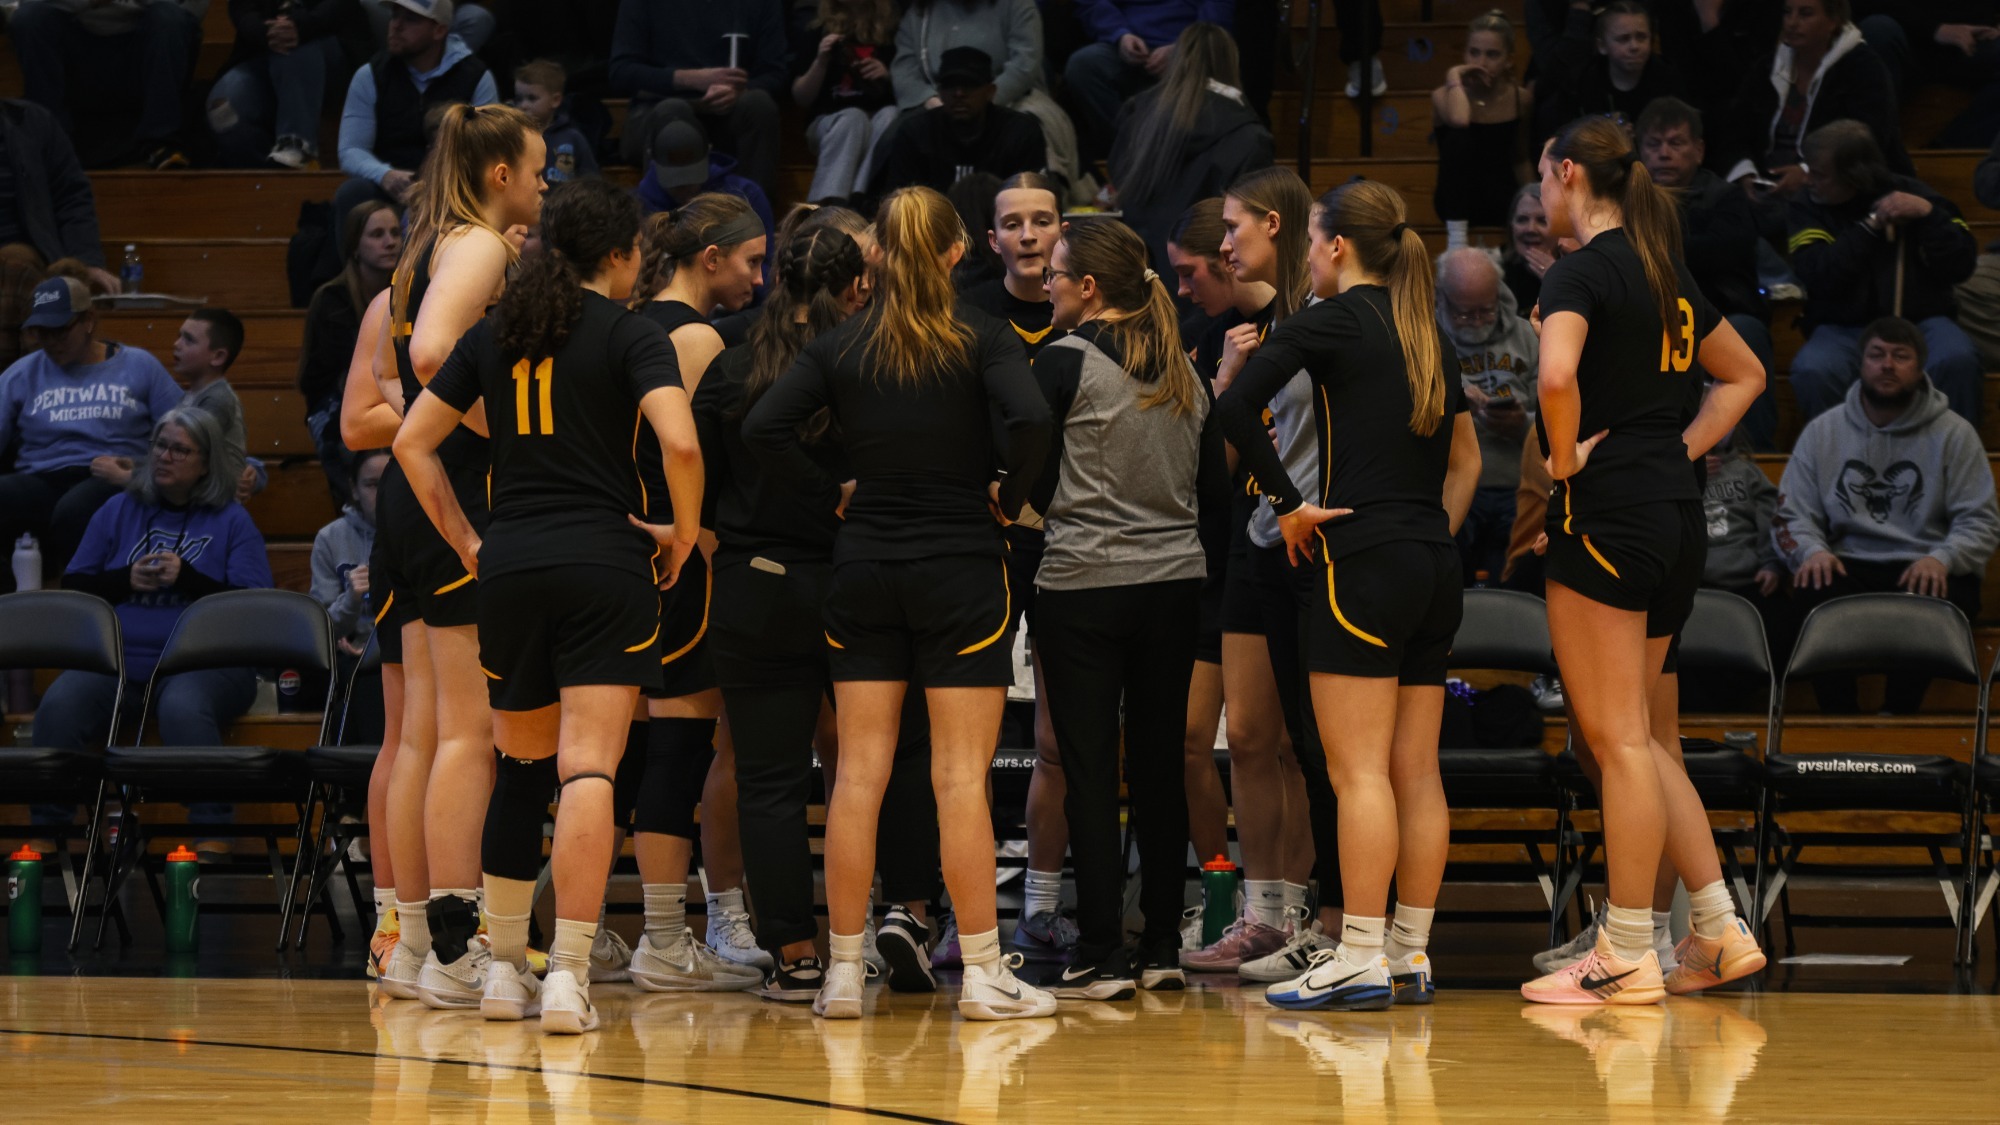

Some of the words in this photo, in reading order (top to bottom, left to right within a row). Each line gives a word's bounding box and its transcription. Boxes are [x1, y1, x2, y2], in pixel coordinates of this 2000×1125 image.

[511, 356, 554, 435] 11
[49, 405, 123, 422] MICHIGAN
[1797, 759, 1917, 774] gvsulakers.com
